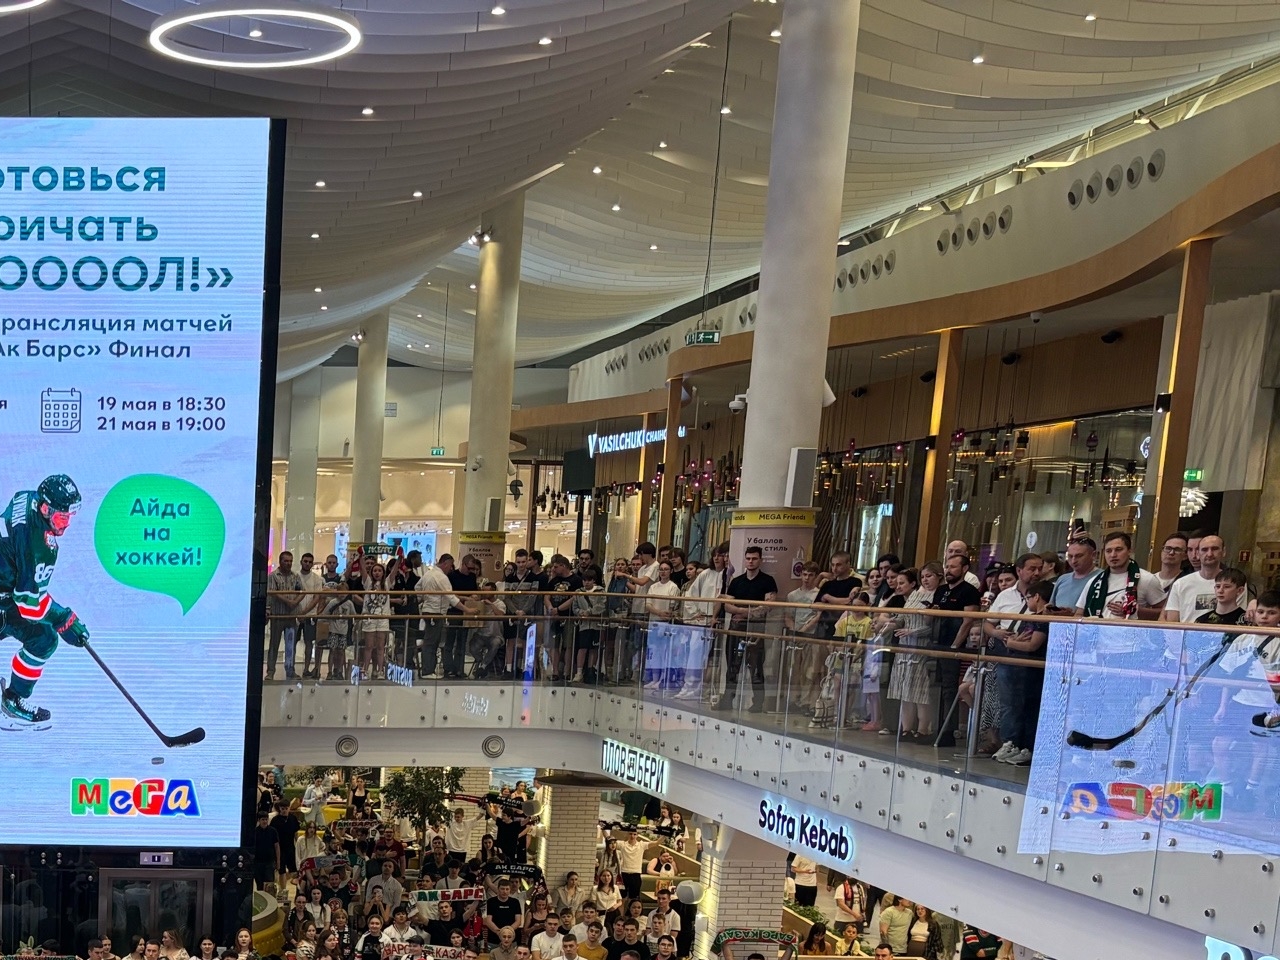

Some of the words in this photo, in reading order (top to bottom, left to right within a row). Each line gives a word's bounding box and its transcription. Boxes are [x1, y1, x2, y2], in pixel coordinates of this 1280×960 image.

[142, 313, 233, 333] матчей
[26, 339, 101, 362] Барс»
[108, 340, 191, 360] Финал
[96, 395, 118, 411] 19
[122, 397, 157, 412] мая
[162, 399, 171, 411] в
[176, 396, 227, 411] 18:30
[96, 416, 118, 431] 21
[122, 418, 157, 431] мая
[162, 419, 171, 431] в
[176, 416, 227, 431] 19:00
[598, 430, 644, 454] VASILCHUKI
[130, 498, 191, 518] Айда
[143, 530, 170, 541] на
[115, 547, 202, 568] хоккей!
[34, 563, 54, 583] 86
[602, 740, 627, 778] ПЛОВ
[636, 752, 666, 793] БЕРИ
[758, 798, 796, 841] Sofra
[798, 814, 850, 861] Kebab
